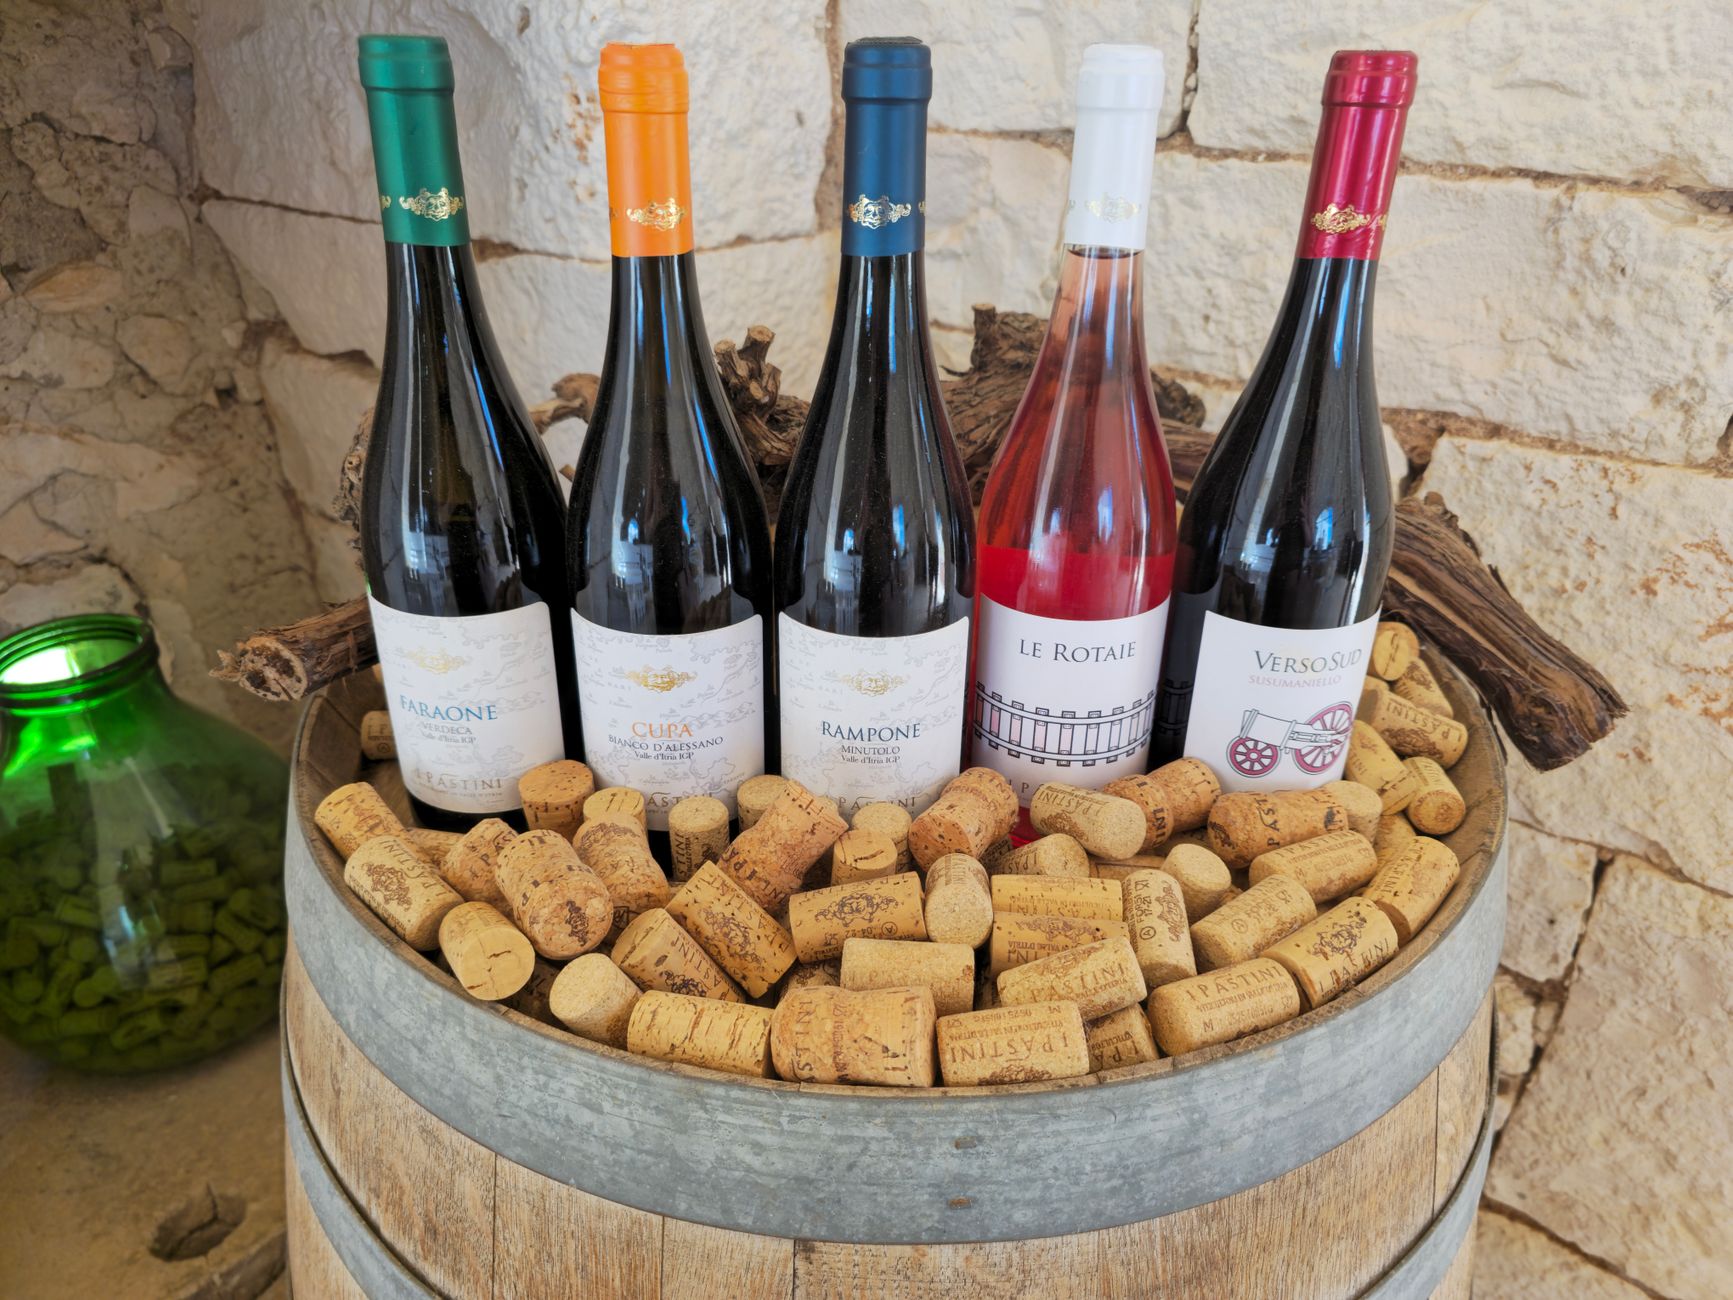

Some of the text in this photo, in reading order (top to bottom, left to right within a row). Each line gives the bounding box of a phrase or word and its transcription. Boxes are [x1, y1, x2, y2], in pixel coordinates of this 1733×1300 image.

[1019, 639, 1136, 663] LE ROTAIE
[1248, 674, 1342, 689] SUSUMANIELLO
[400, 694, 498, 721] FARAONE
[421, 722, 473, 735] VERDECA
[631, 721, 694, 739] CUPA
[821, 720, 921, 742] RAMPONE
[1385, 702, 1452, 740] PASTINI
[608, 734, 724, 752] BIANCO D'ALESSANO
[841, 744, 901, 756] MINUTOLO
[634, 750, 653, 760] Valle
[679, 751, 695, 760] IGP
[841, 754, 901, 764] Valle d'Itria IGP
[1254, 798, 1281, 849] PAST
[379, 838, 439, 888] PASTINI
[674, 832, 687, 876] STINI
[1197, 967, 1282, 998] PASTINI
[950, 1032, 1069, 1063] I PASTINI
